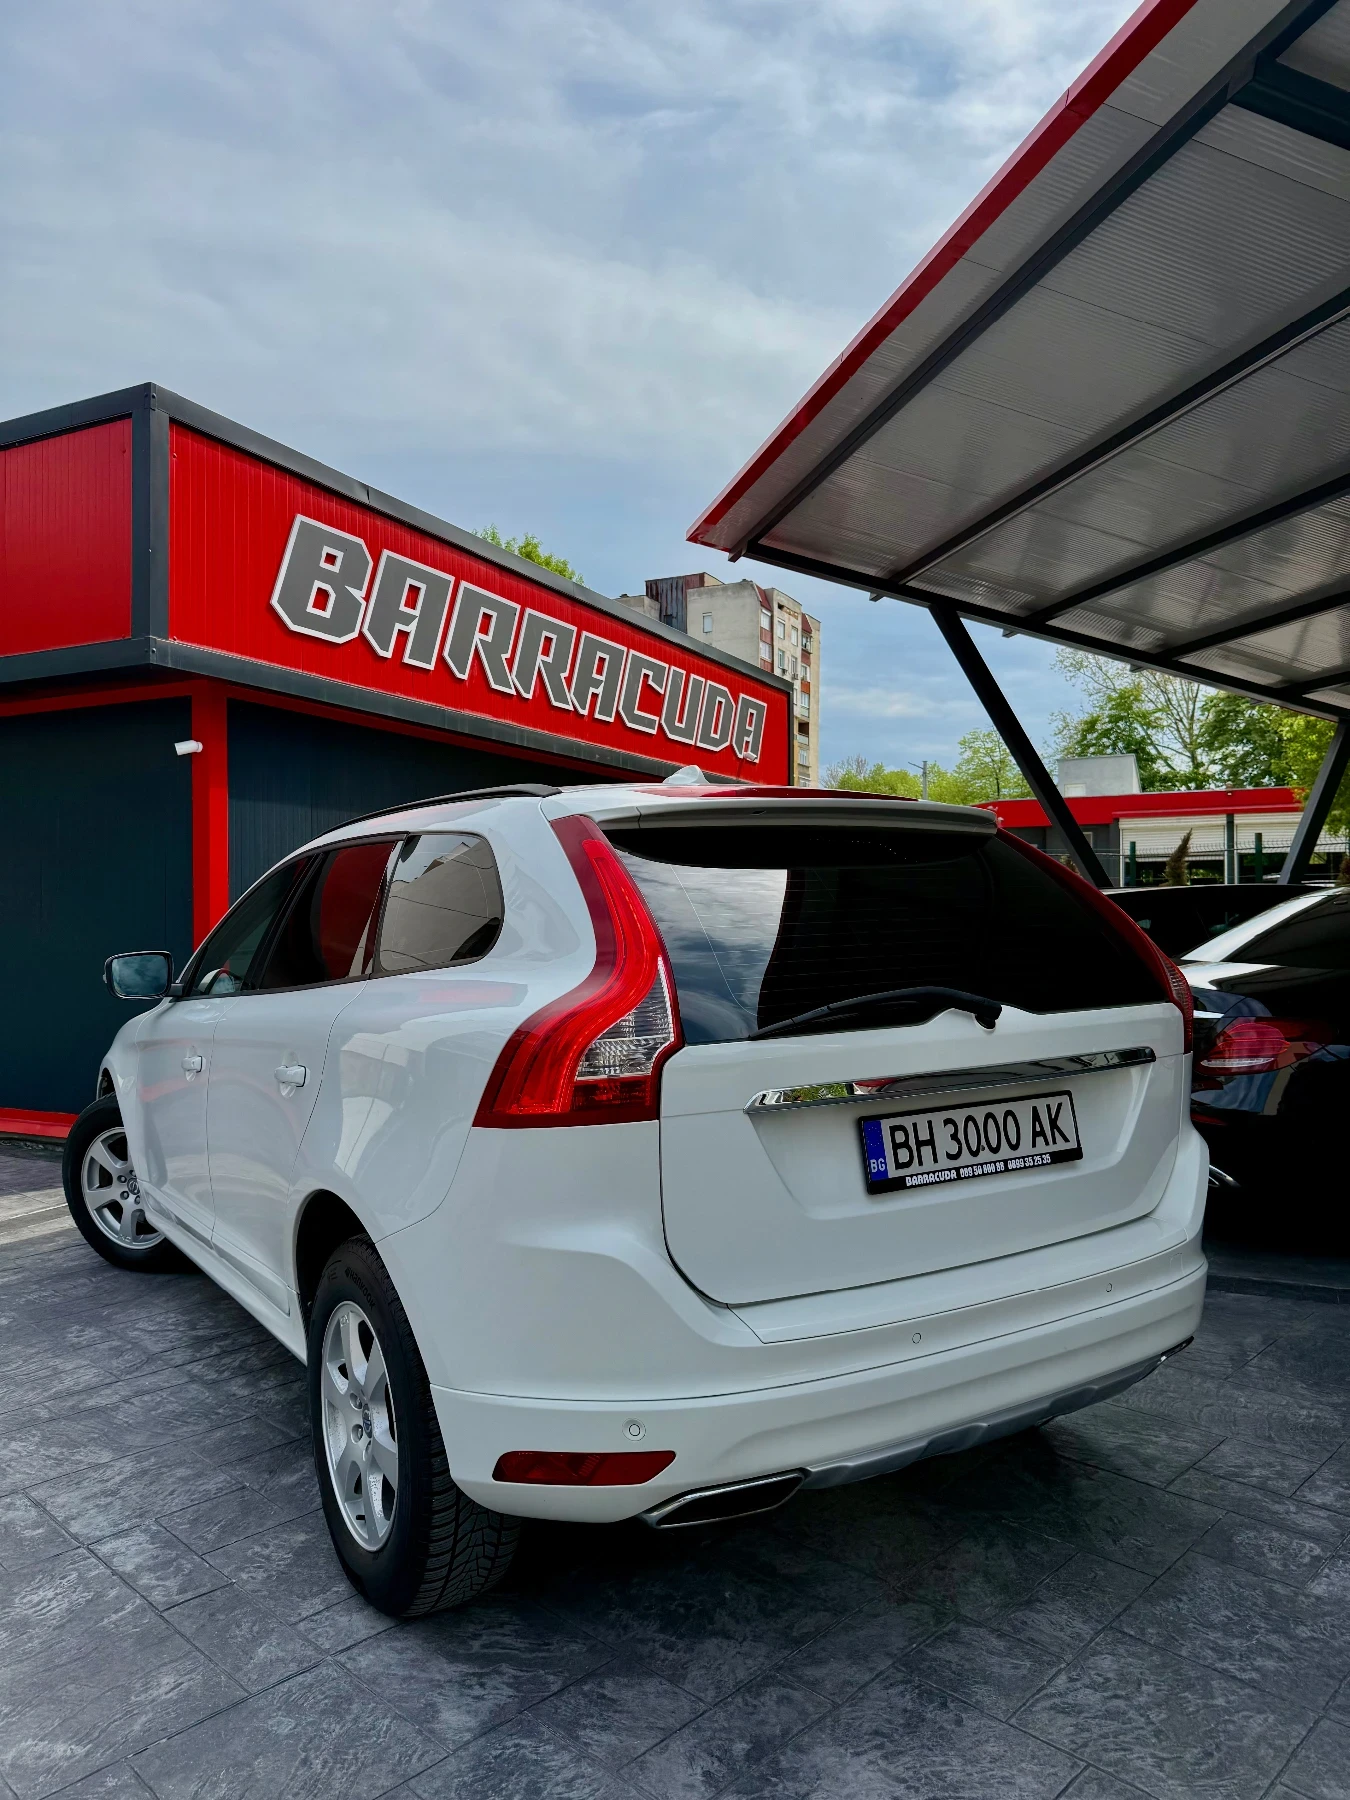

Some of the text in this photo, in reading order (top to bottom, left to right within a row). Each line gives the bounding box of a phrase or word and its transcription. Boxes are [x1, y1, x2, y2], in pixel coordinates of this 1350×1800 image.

[270, 514, 767, 763] BARRACUDA
[889, 1102, 1071, 1171] BH 3000 AK
[870, 1158, 886, 1173] BG
[905, 1169, 958, 1187] BARRACUDA
